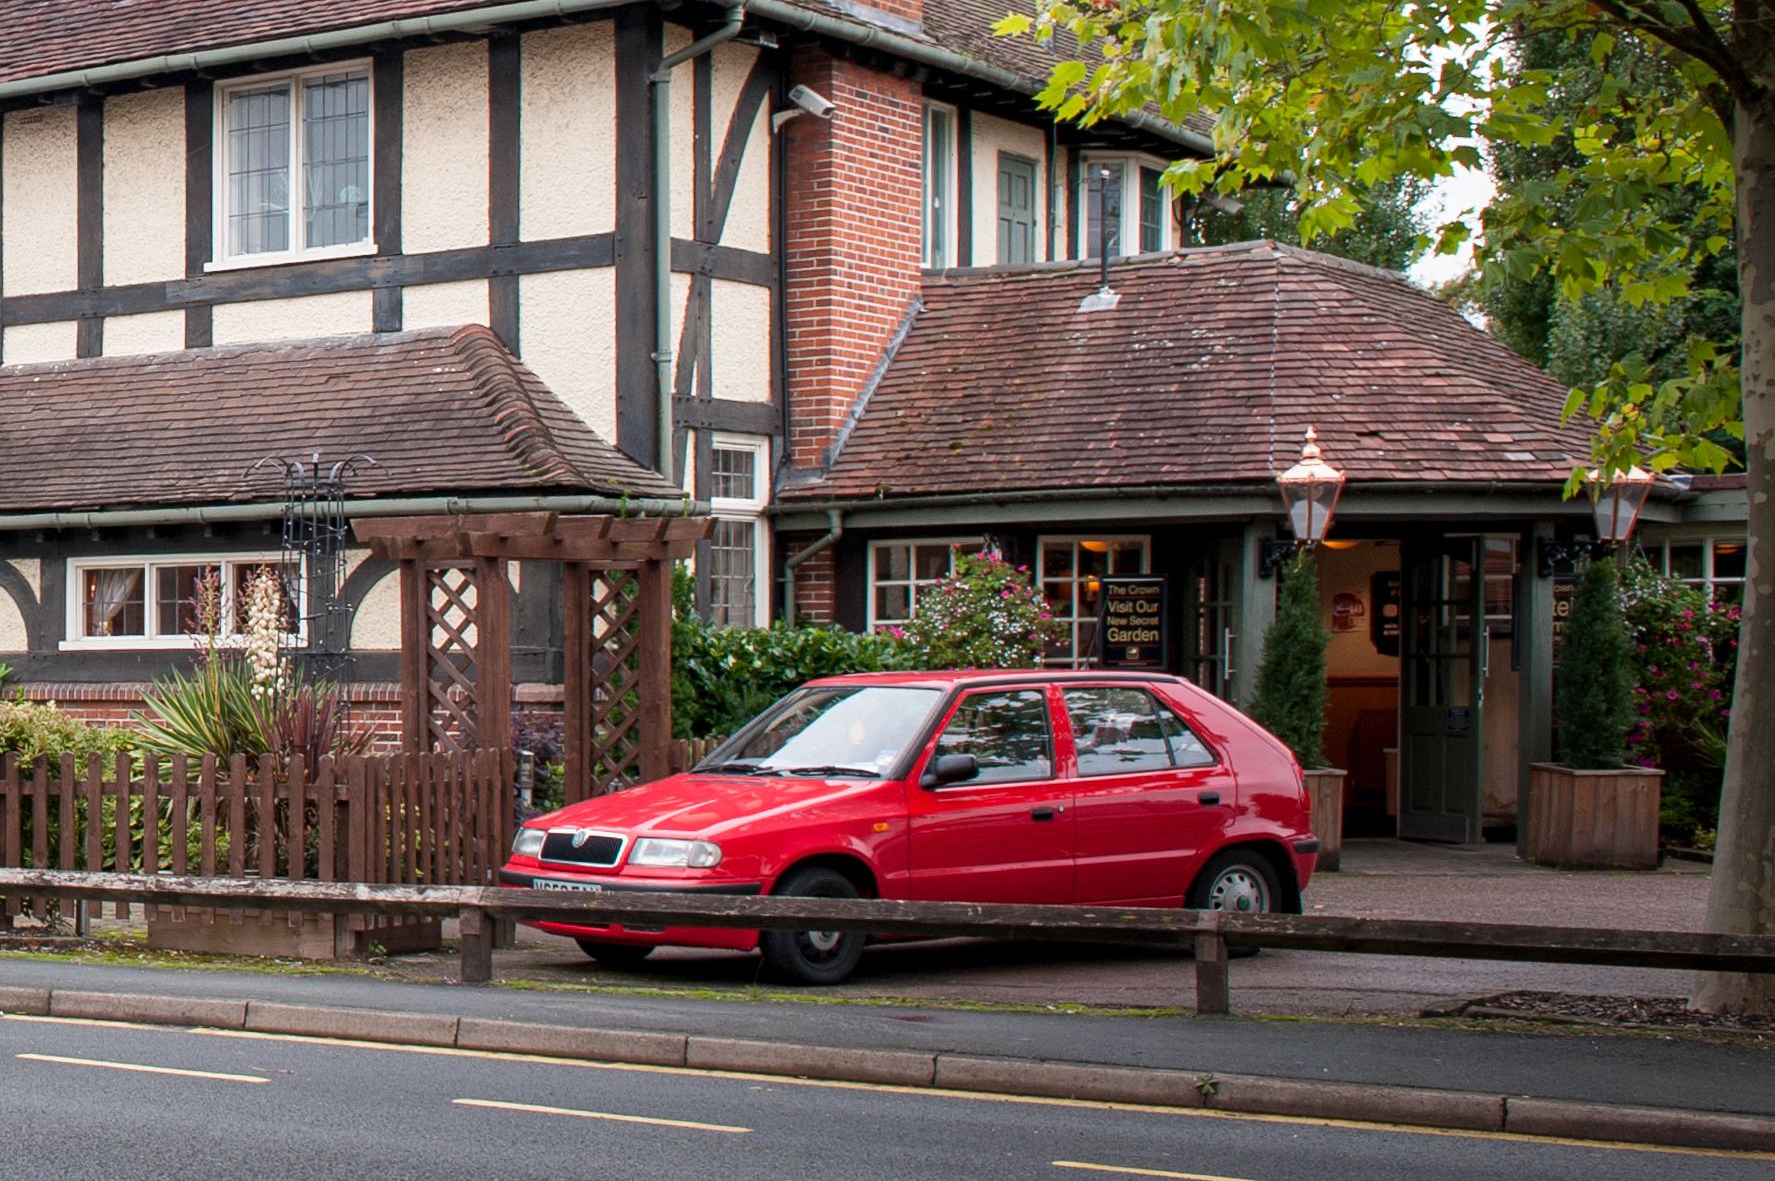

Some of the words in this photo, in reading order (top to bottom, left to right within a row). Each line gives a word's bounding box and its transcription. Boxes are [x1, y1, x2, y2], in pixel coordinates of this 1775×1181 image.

[1107, 584, 1126, 595] The
[1128, 584, 1160, 595] Crown
[1107, 600, 1133, 613] Visit
[1135, 600, 1160, 613] Our
[1106, 616, 1128, 625] New
[1129, 615, 1159, 626] Secret
[1107, 627, 1159, 642] Garden
